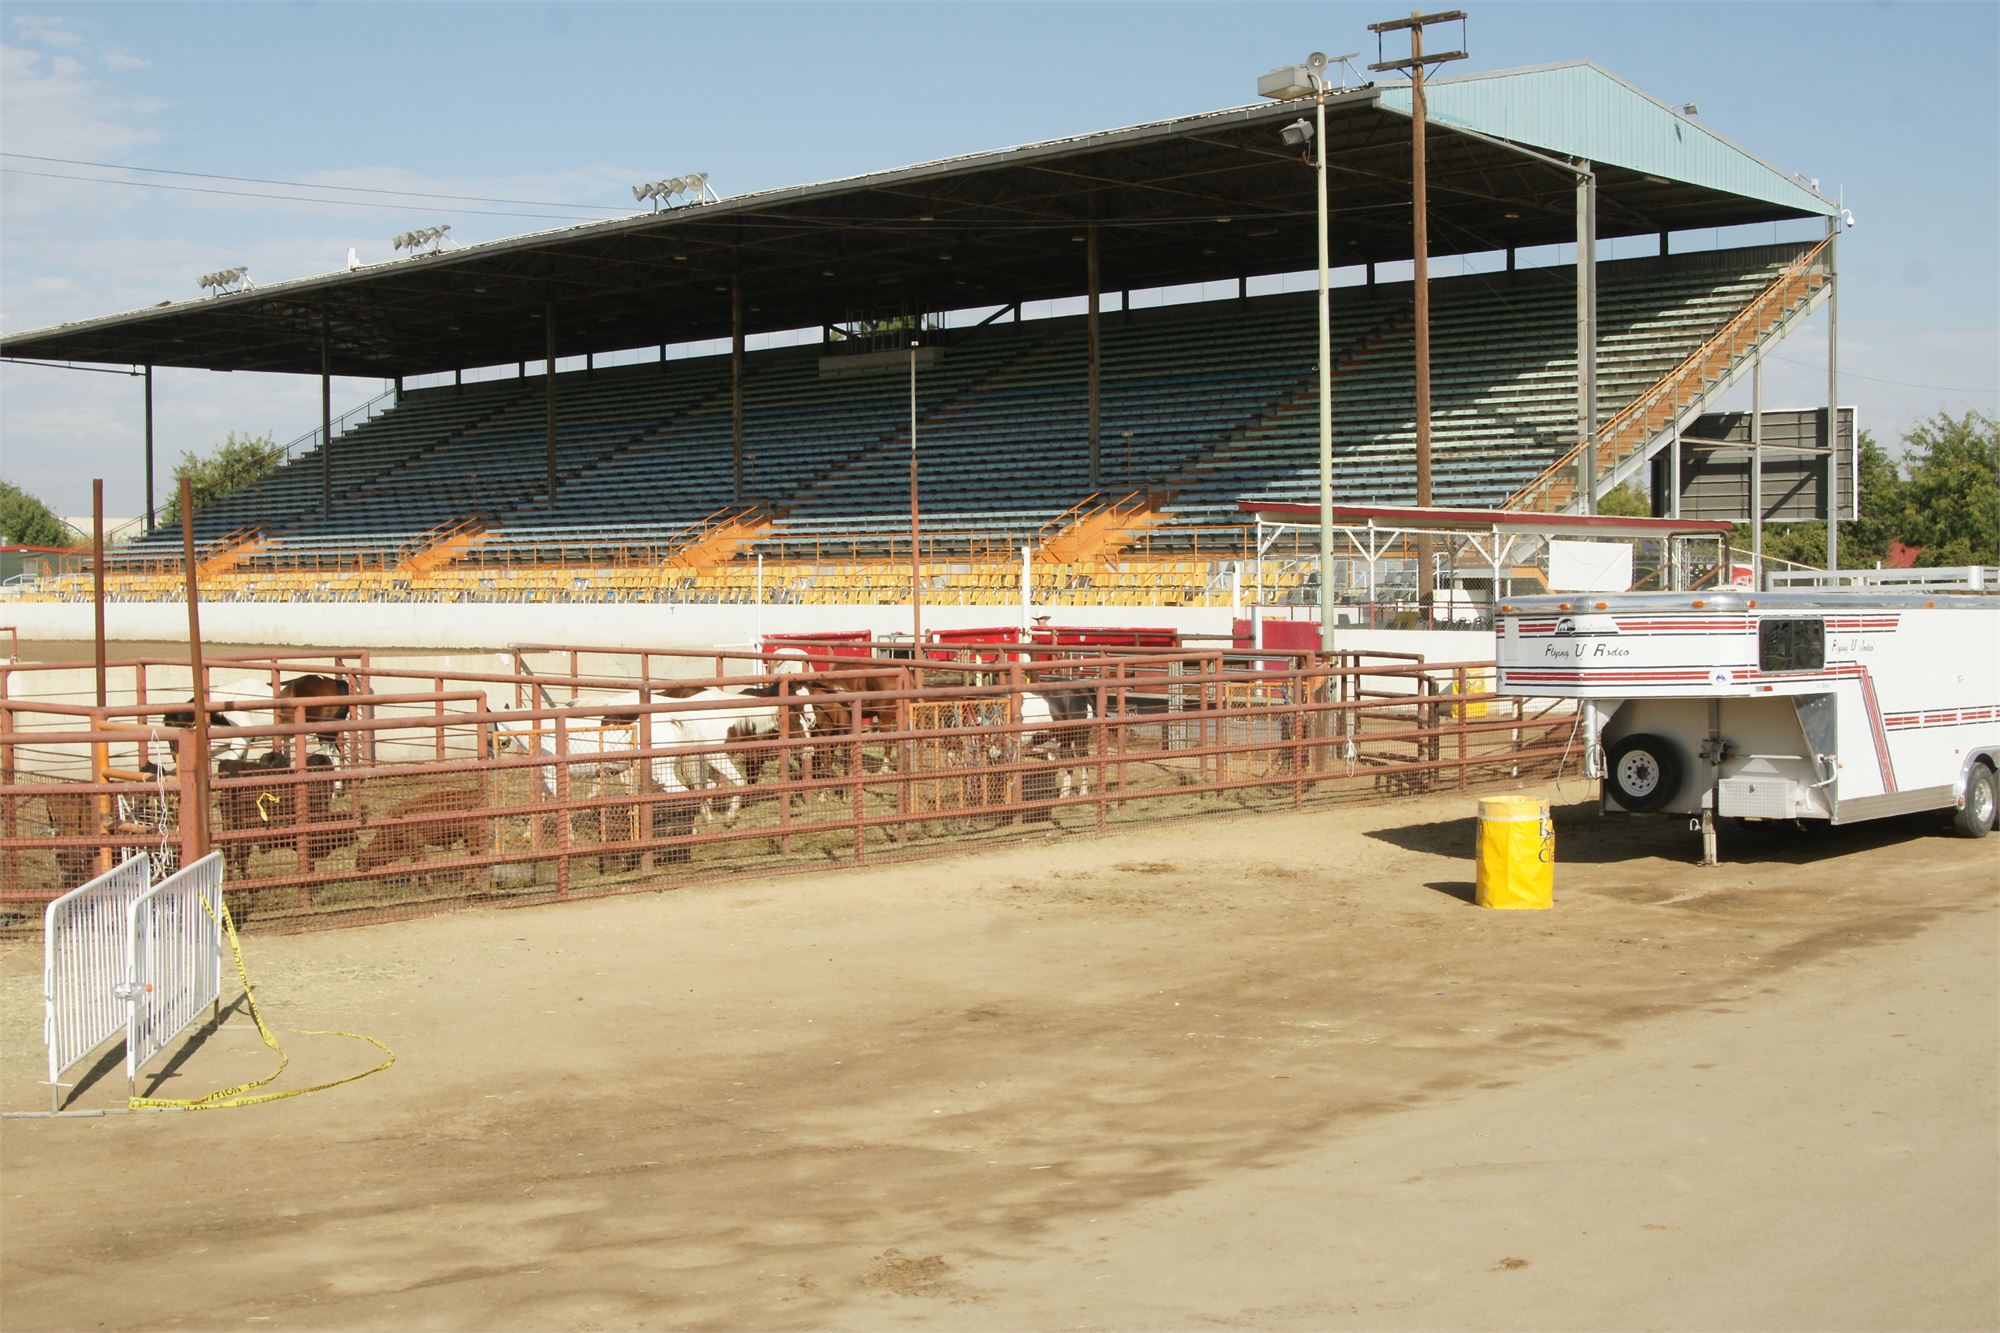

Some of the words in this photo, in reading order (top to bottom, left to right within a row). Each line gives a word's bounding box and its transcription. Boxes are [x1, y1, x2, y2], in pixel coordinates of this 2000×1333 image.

[1545, 644, 1569, 659] Flying
[1575, 643, 1587, 657] U
[1594, 643, 1630, 657] Rodeo
